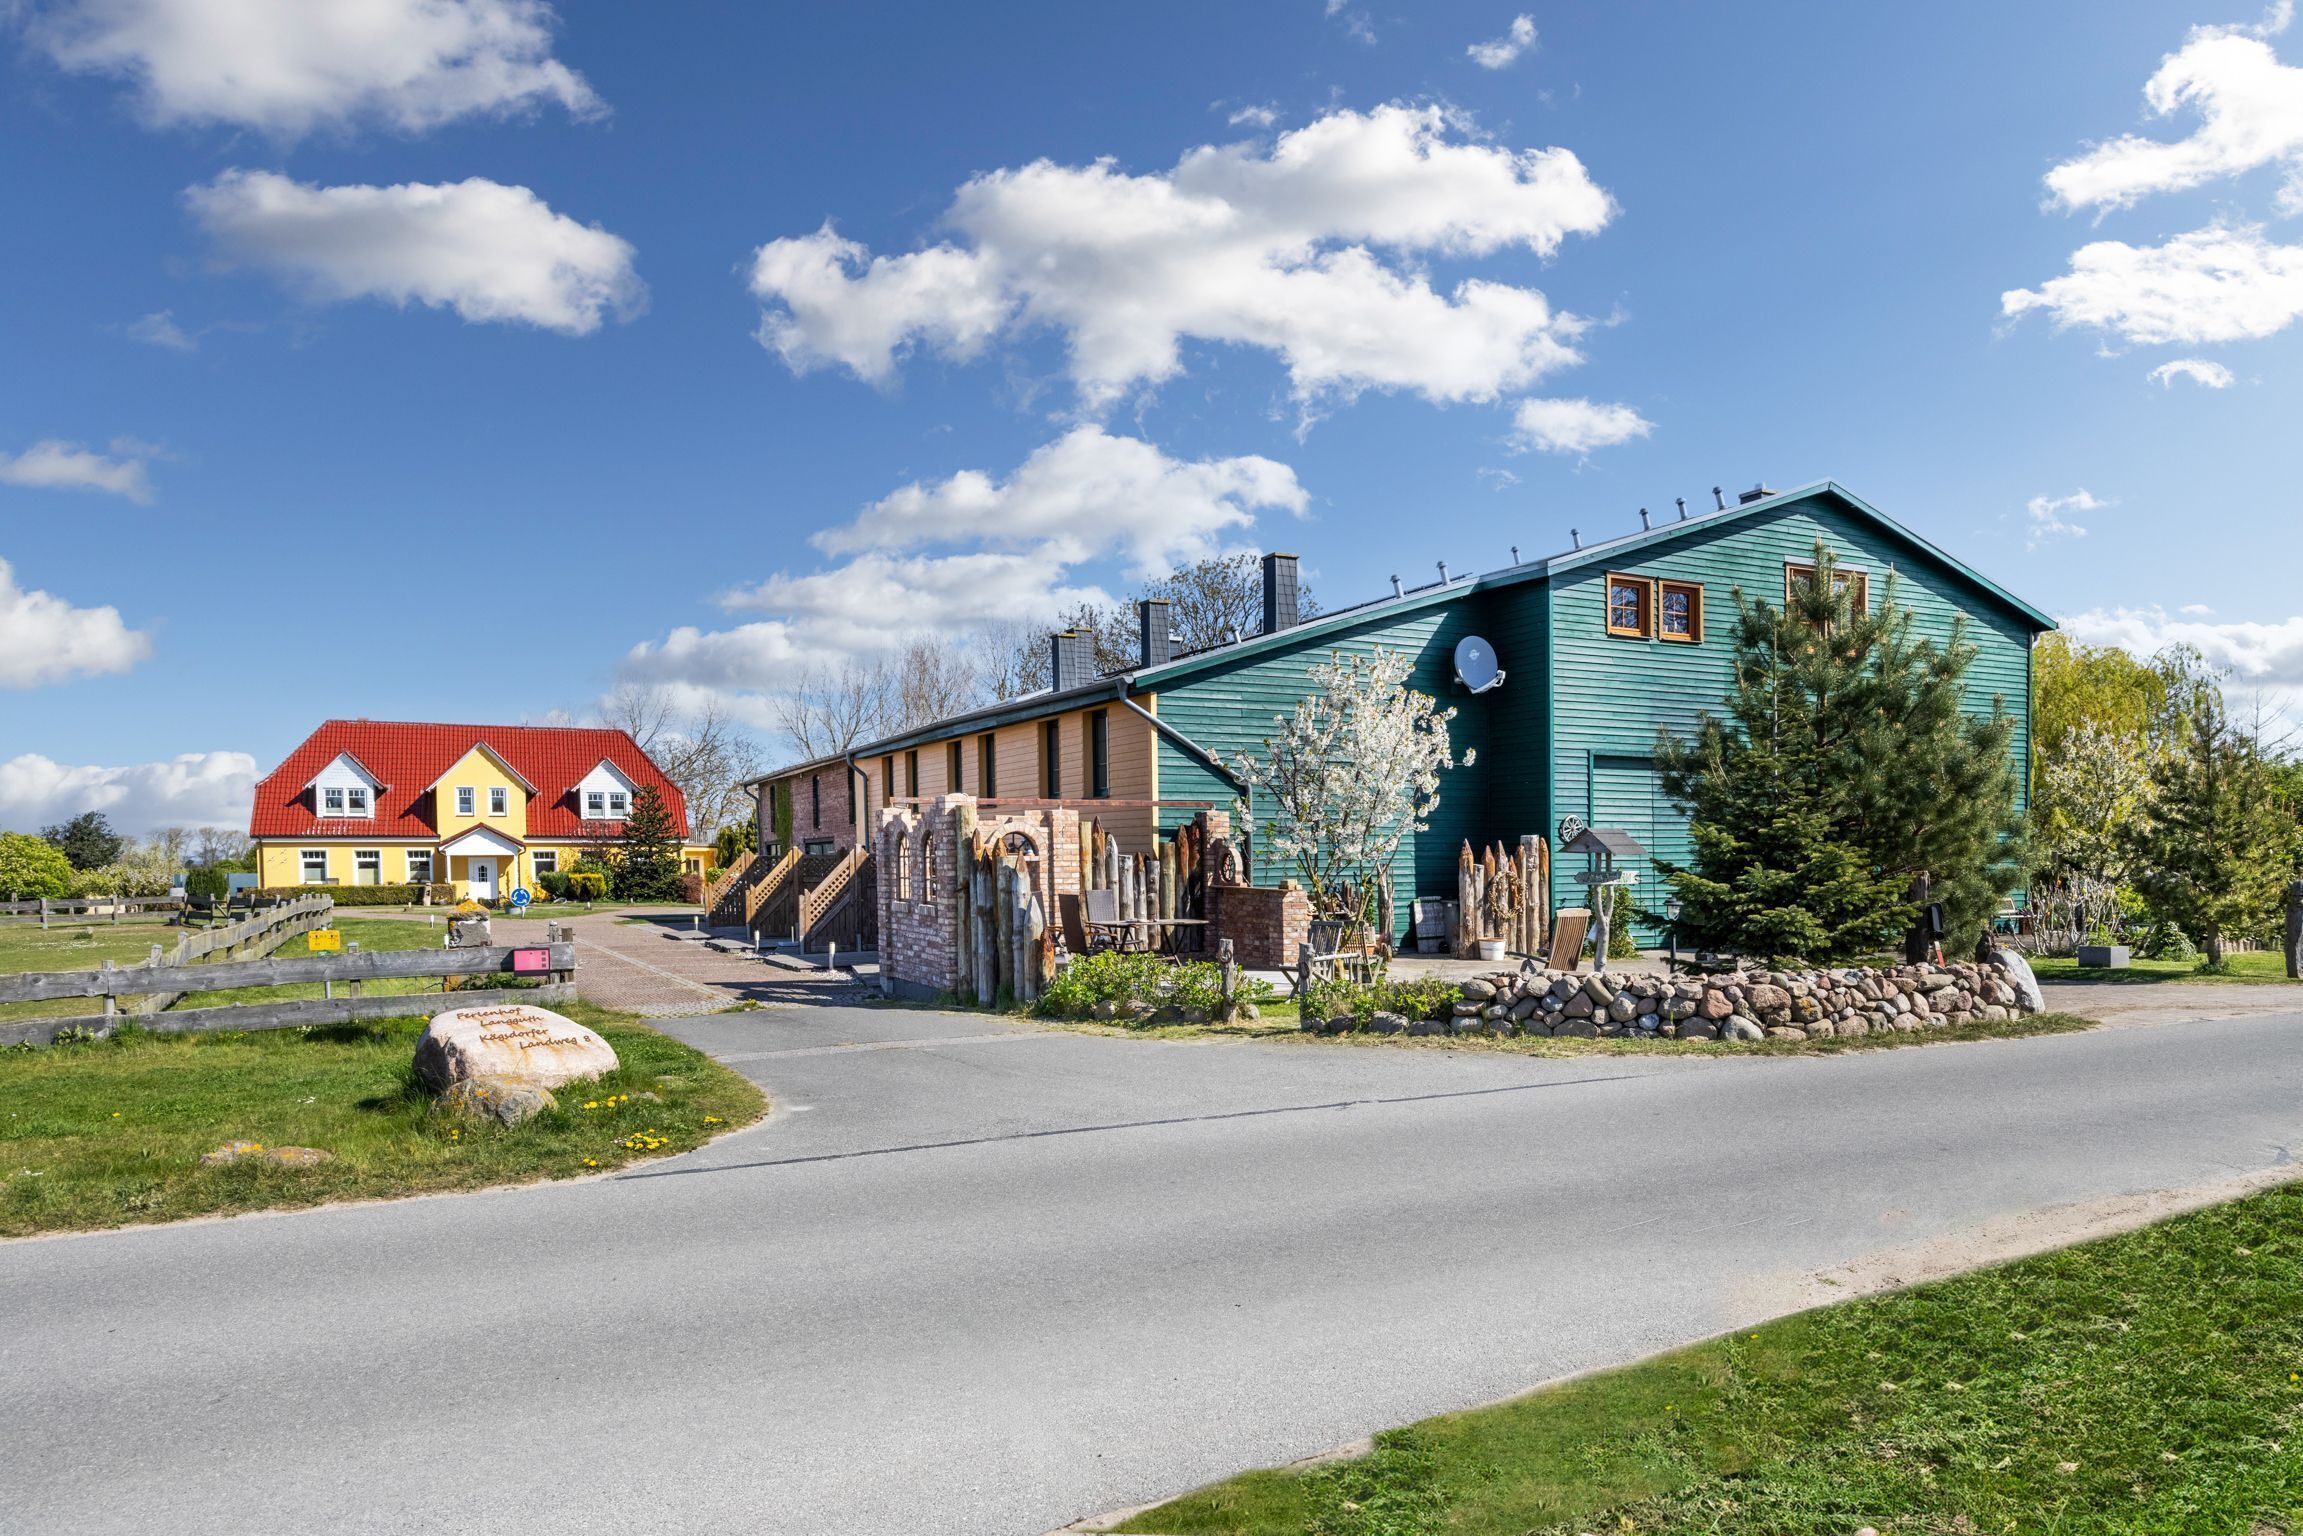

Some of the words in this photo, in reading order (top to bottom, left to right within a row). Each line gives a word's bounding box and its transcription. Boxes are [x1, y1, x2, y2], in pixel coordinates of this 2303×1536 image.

[456, 1007, 523, 1019] Ferienhof
[480, 1015, 544, 1027] Langguth
[479, 1028, 548, 1042] Kägsdorfer
[519, 1036, 578, 1050] Landweg
[583, 1035, 591, 1043] 8
